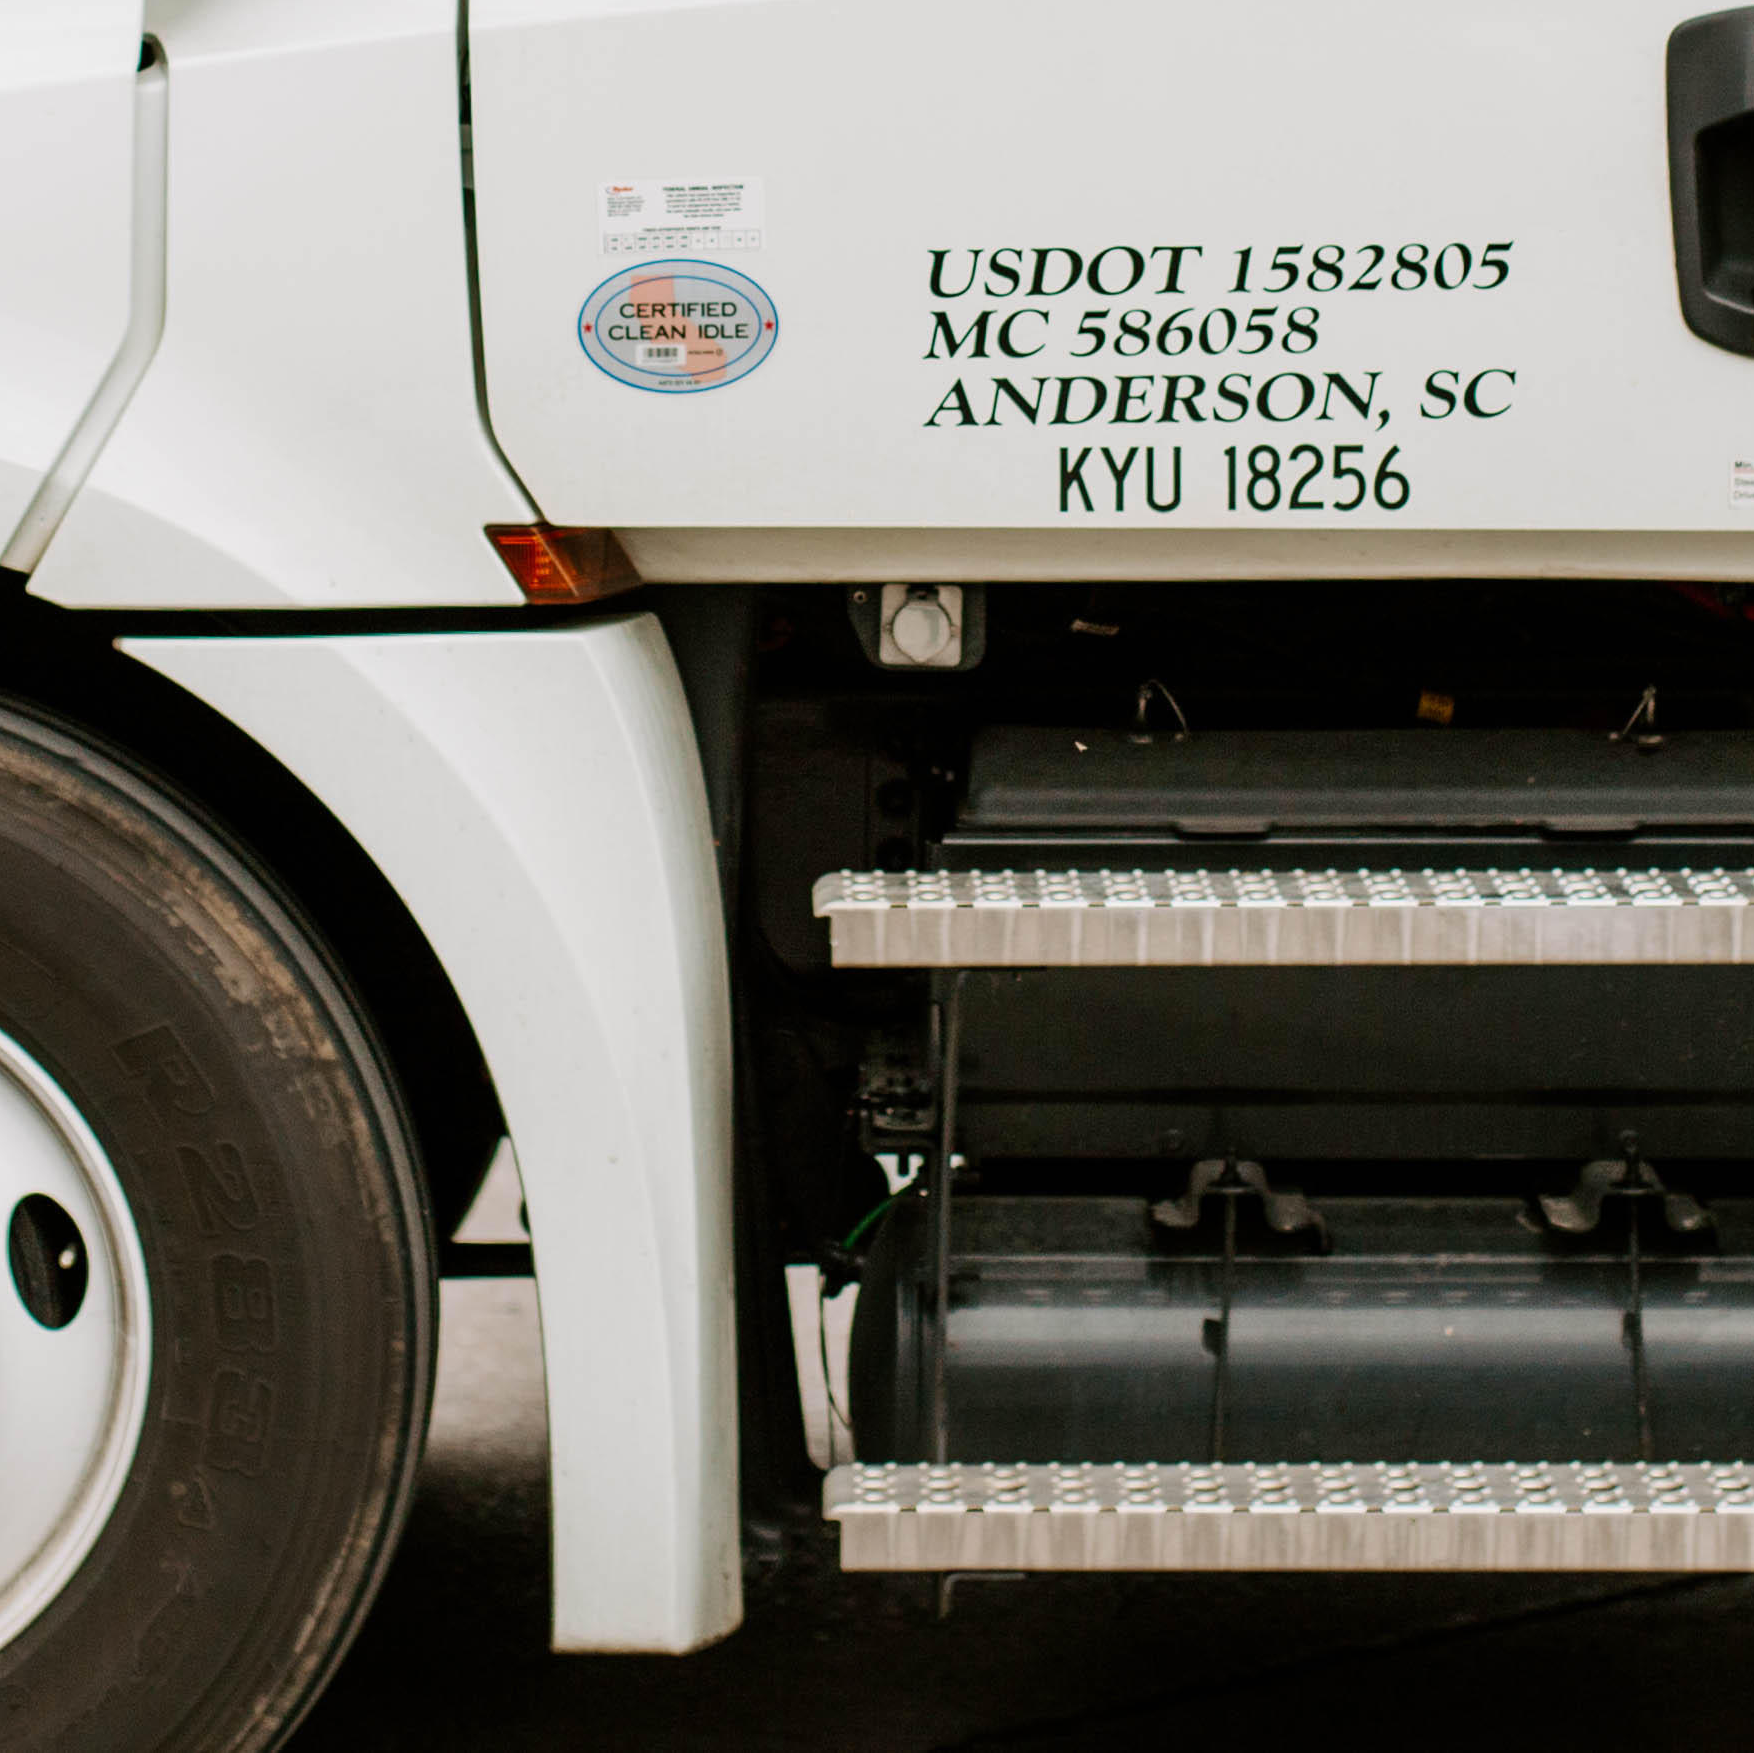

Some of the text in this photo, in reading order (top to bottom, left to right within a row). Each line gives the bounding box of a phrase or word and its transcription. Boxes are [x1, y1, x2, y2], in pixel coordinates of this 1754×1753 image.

[928, 241, 1514, 299] USDOT 1582805
[608, 323, 749, 341] CLEAN IDLE
[619, 301, 737, 319] CERTIFIED
[923, 306, 1320, 359] MC 586058
[923, 369, 1516, 431] ANDERSON, SC
[1059, 443, 1411, 513] KYU 18256
